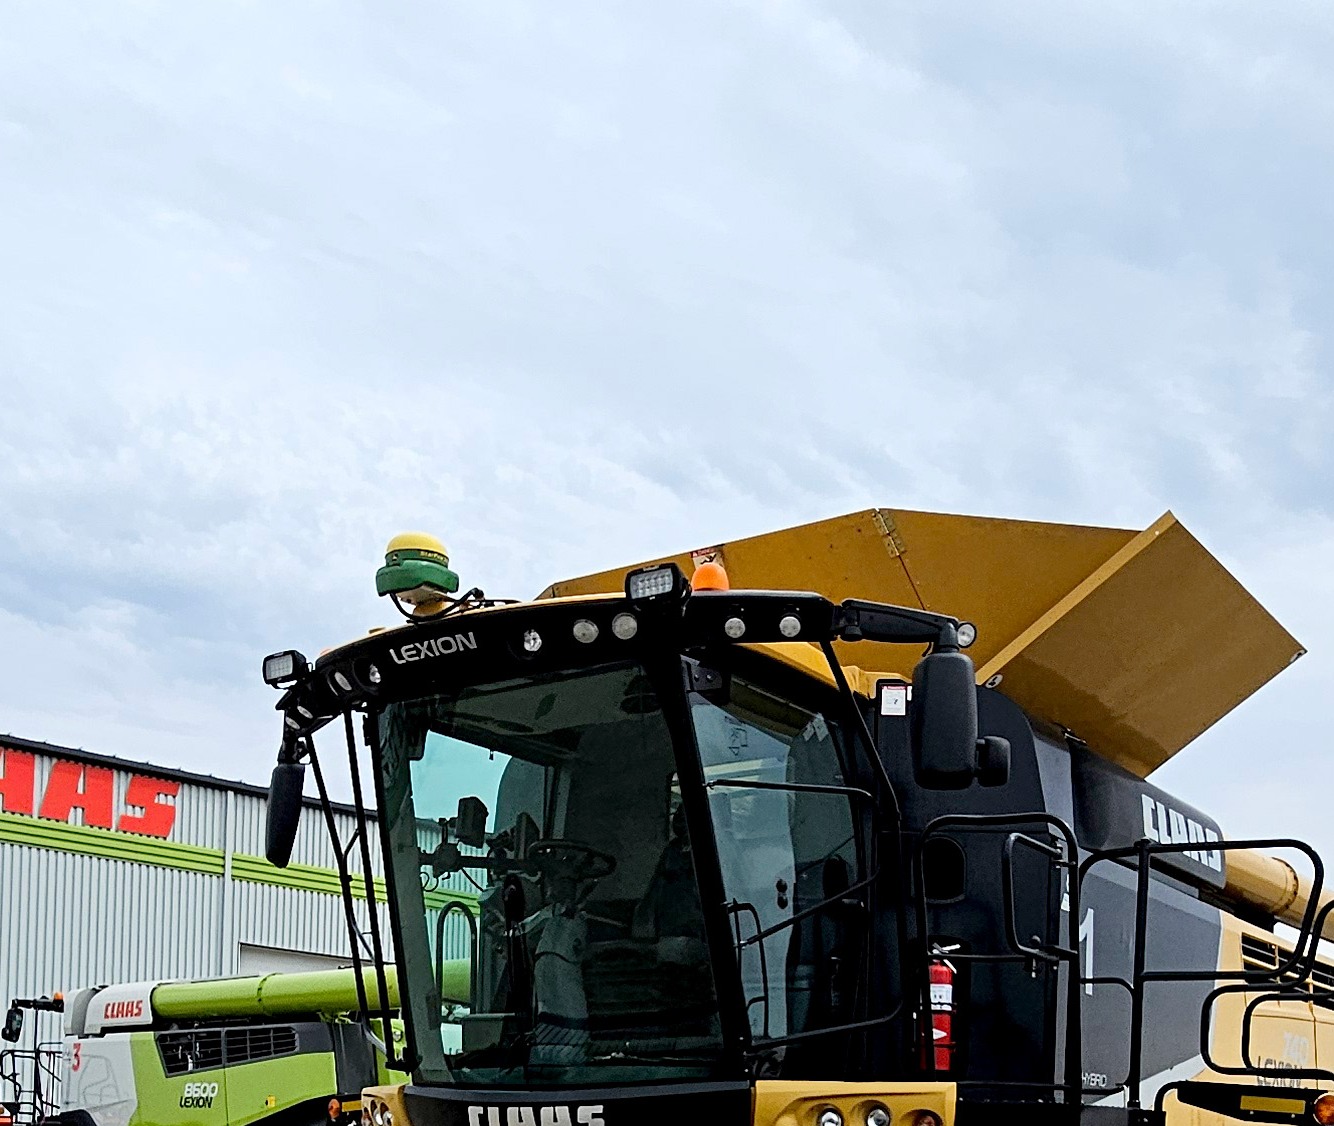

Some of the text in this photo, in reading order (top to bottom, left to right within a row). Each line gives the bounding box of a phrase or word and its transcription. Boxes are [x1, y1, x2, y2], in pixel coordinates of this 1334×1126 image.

[389, 631, 477, 664] LEXION
[1142, 794, 1221, 872] CLAAS
[104, 1000, 143, 1019] CLAAS
[72, 1043, 81, 1072] 3
[184, 1082, 218, 1097] 8600
[179, 1096, 213, 1108] LEXION
